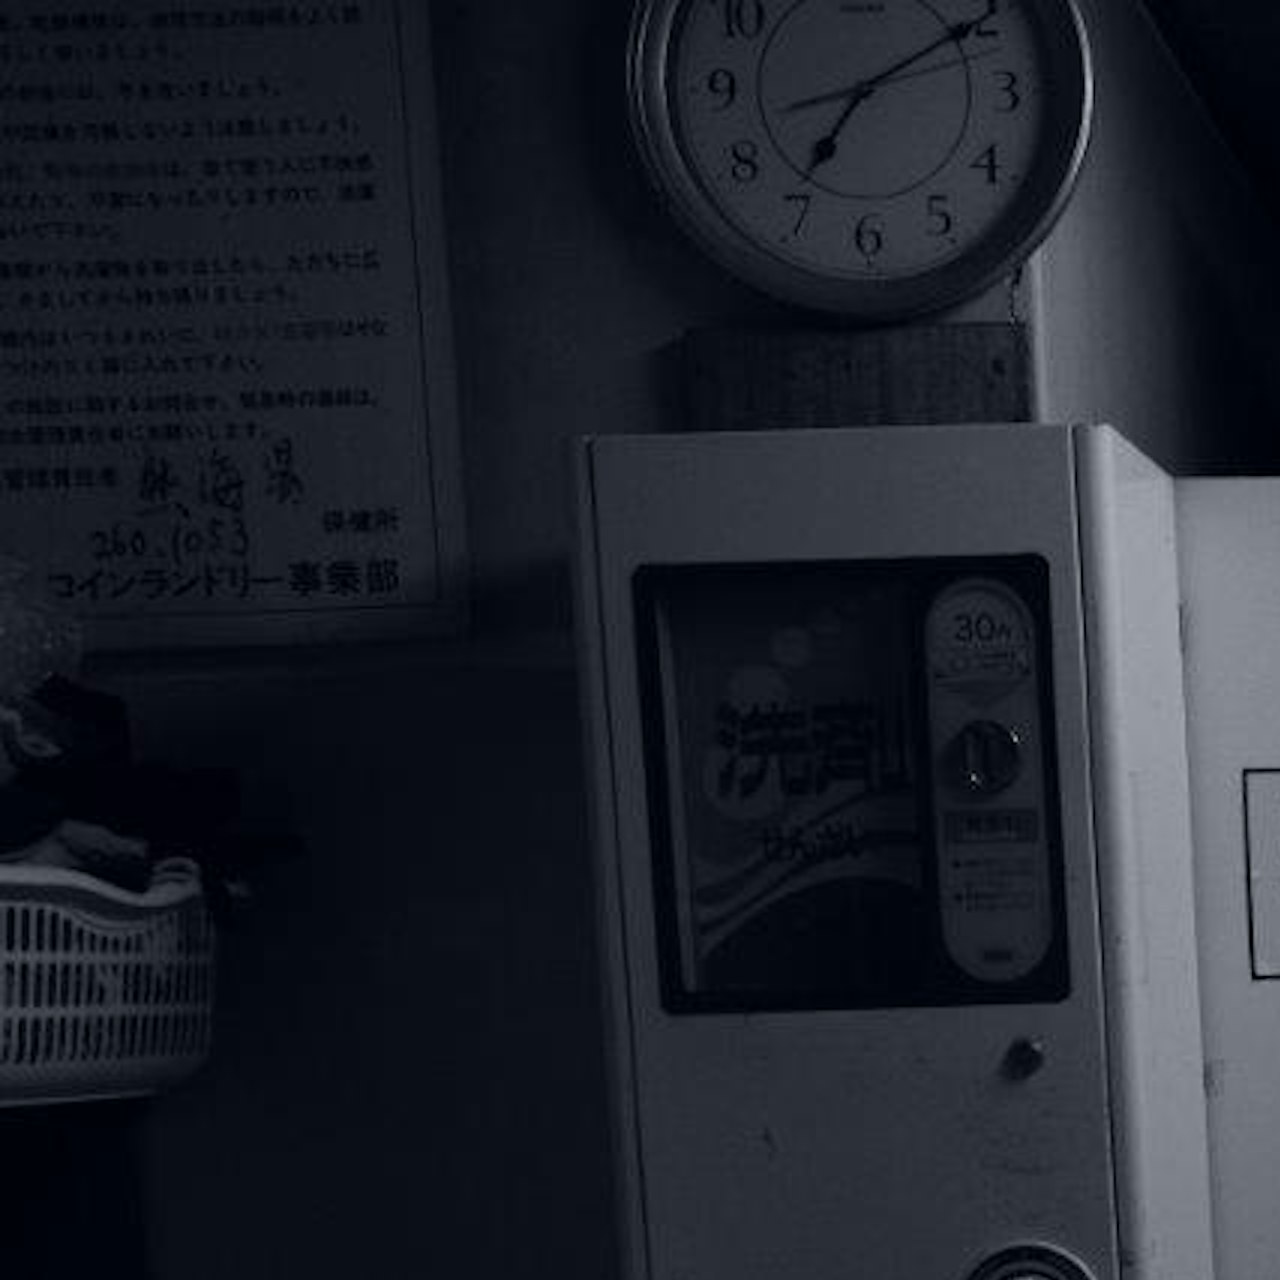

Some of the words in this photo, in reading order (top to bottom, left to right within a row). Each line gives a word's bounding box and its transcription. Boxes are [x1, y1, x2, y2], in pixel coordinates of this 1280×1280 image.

[708, 68, 735, 109] 9
[993, 72, 1019, 111] 3
[731, 140, 759, 182] 8
[970, 144, 1001, 184] 4
[784, 195, 811, 236] 7
[854, 213, 883, 257] 6
[926, 195, 951, 236] 5
[48, 558, 399, 600] コインランドリー事業部
